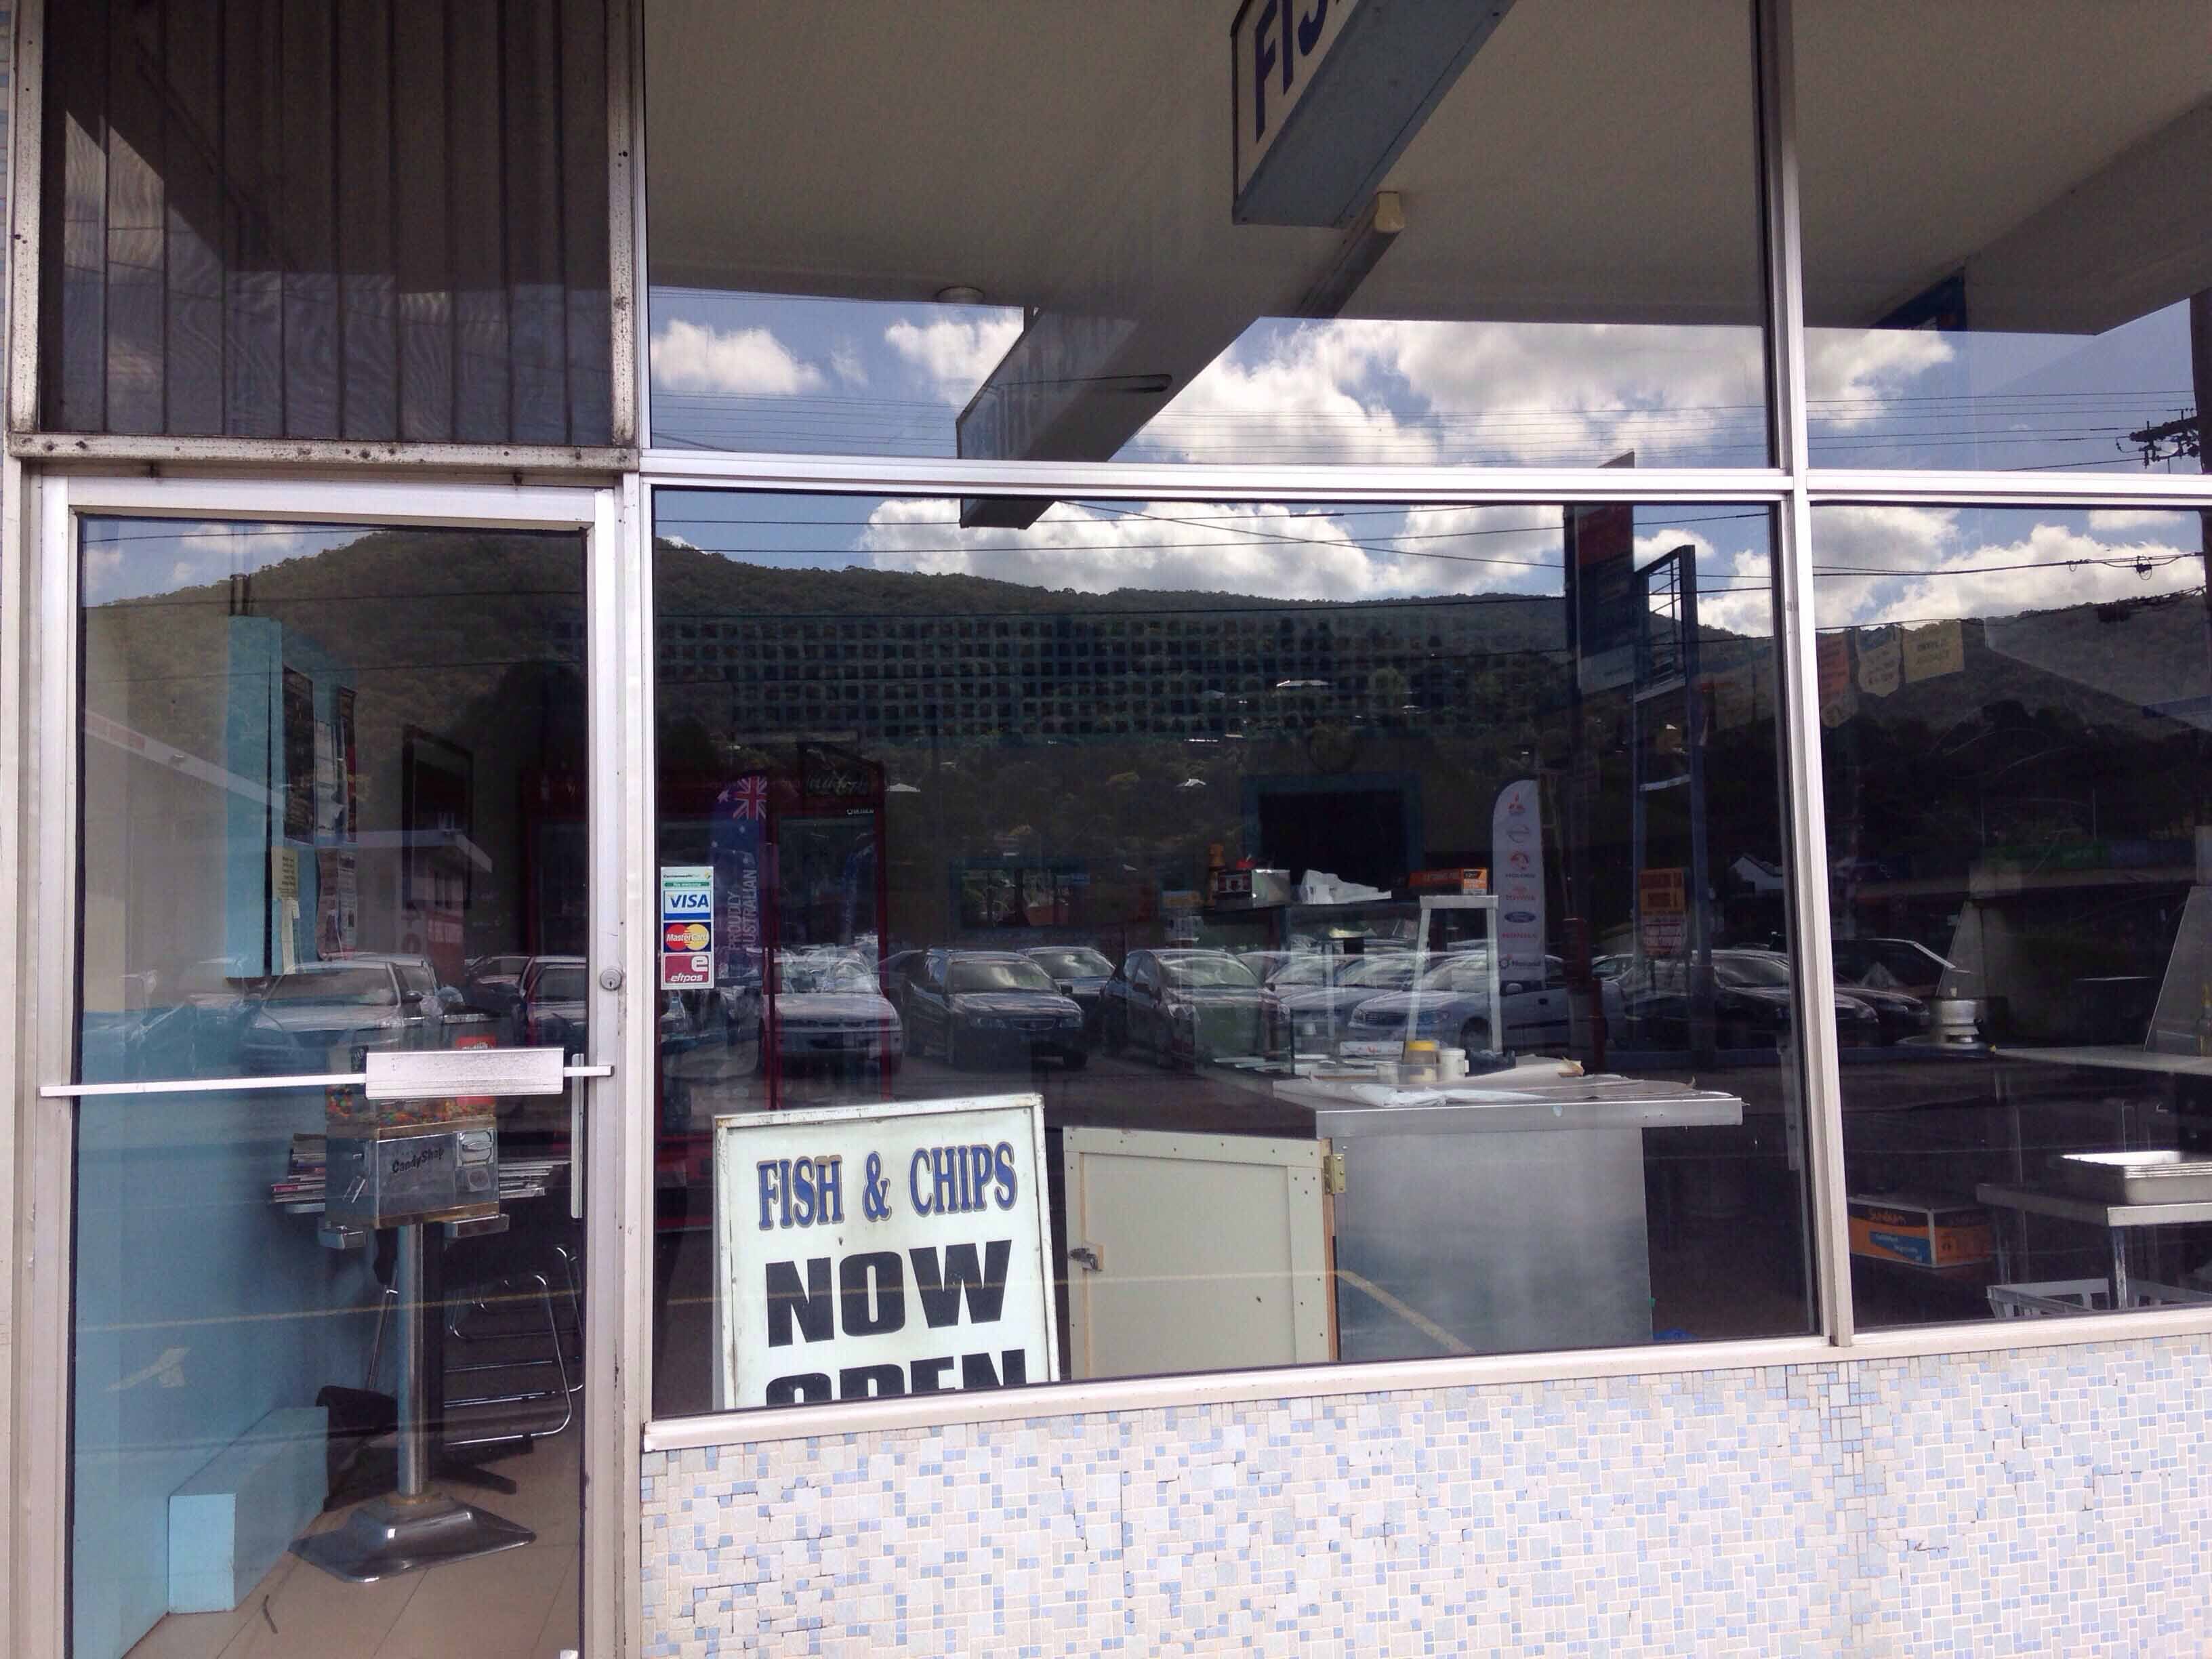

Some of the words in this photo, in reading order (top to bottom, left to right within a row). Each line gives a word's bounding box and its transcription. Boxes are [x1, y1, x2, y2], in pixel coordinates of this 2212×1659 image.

[670, 894, 709, 908] VISA
[727, 890, 741, 951] PROUDLY
[742, 869, 757, 954] AUSTRALIAN
[666, 933, 708, 942] MasterCard
[670, 972, 703, 983] eftpos
[756, 1154, 845, 1231] FISH
[862, 1151, 892, 1221] &
[908, 1141, 1018, 1218] CHIPS
[764, 1239, 1012, 1349] NOW
